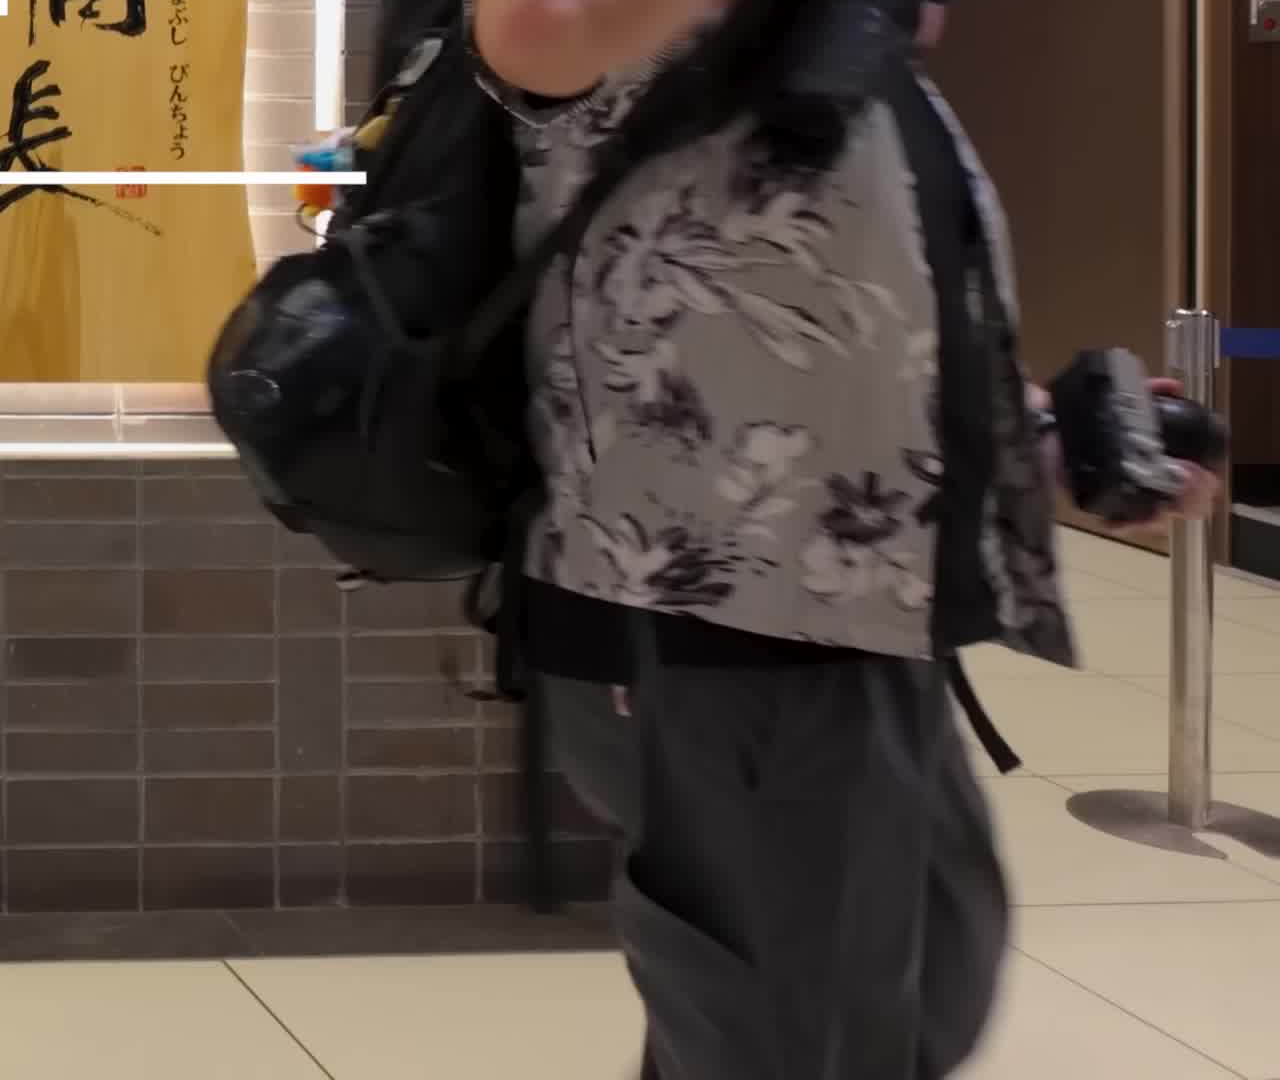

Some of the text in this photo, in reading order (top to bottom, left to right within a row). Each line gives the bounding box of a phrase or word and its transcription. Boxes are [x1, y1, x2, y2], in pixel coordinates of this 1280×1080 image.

[168, 63, 189, 161] びんちょう
